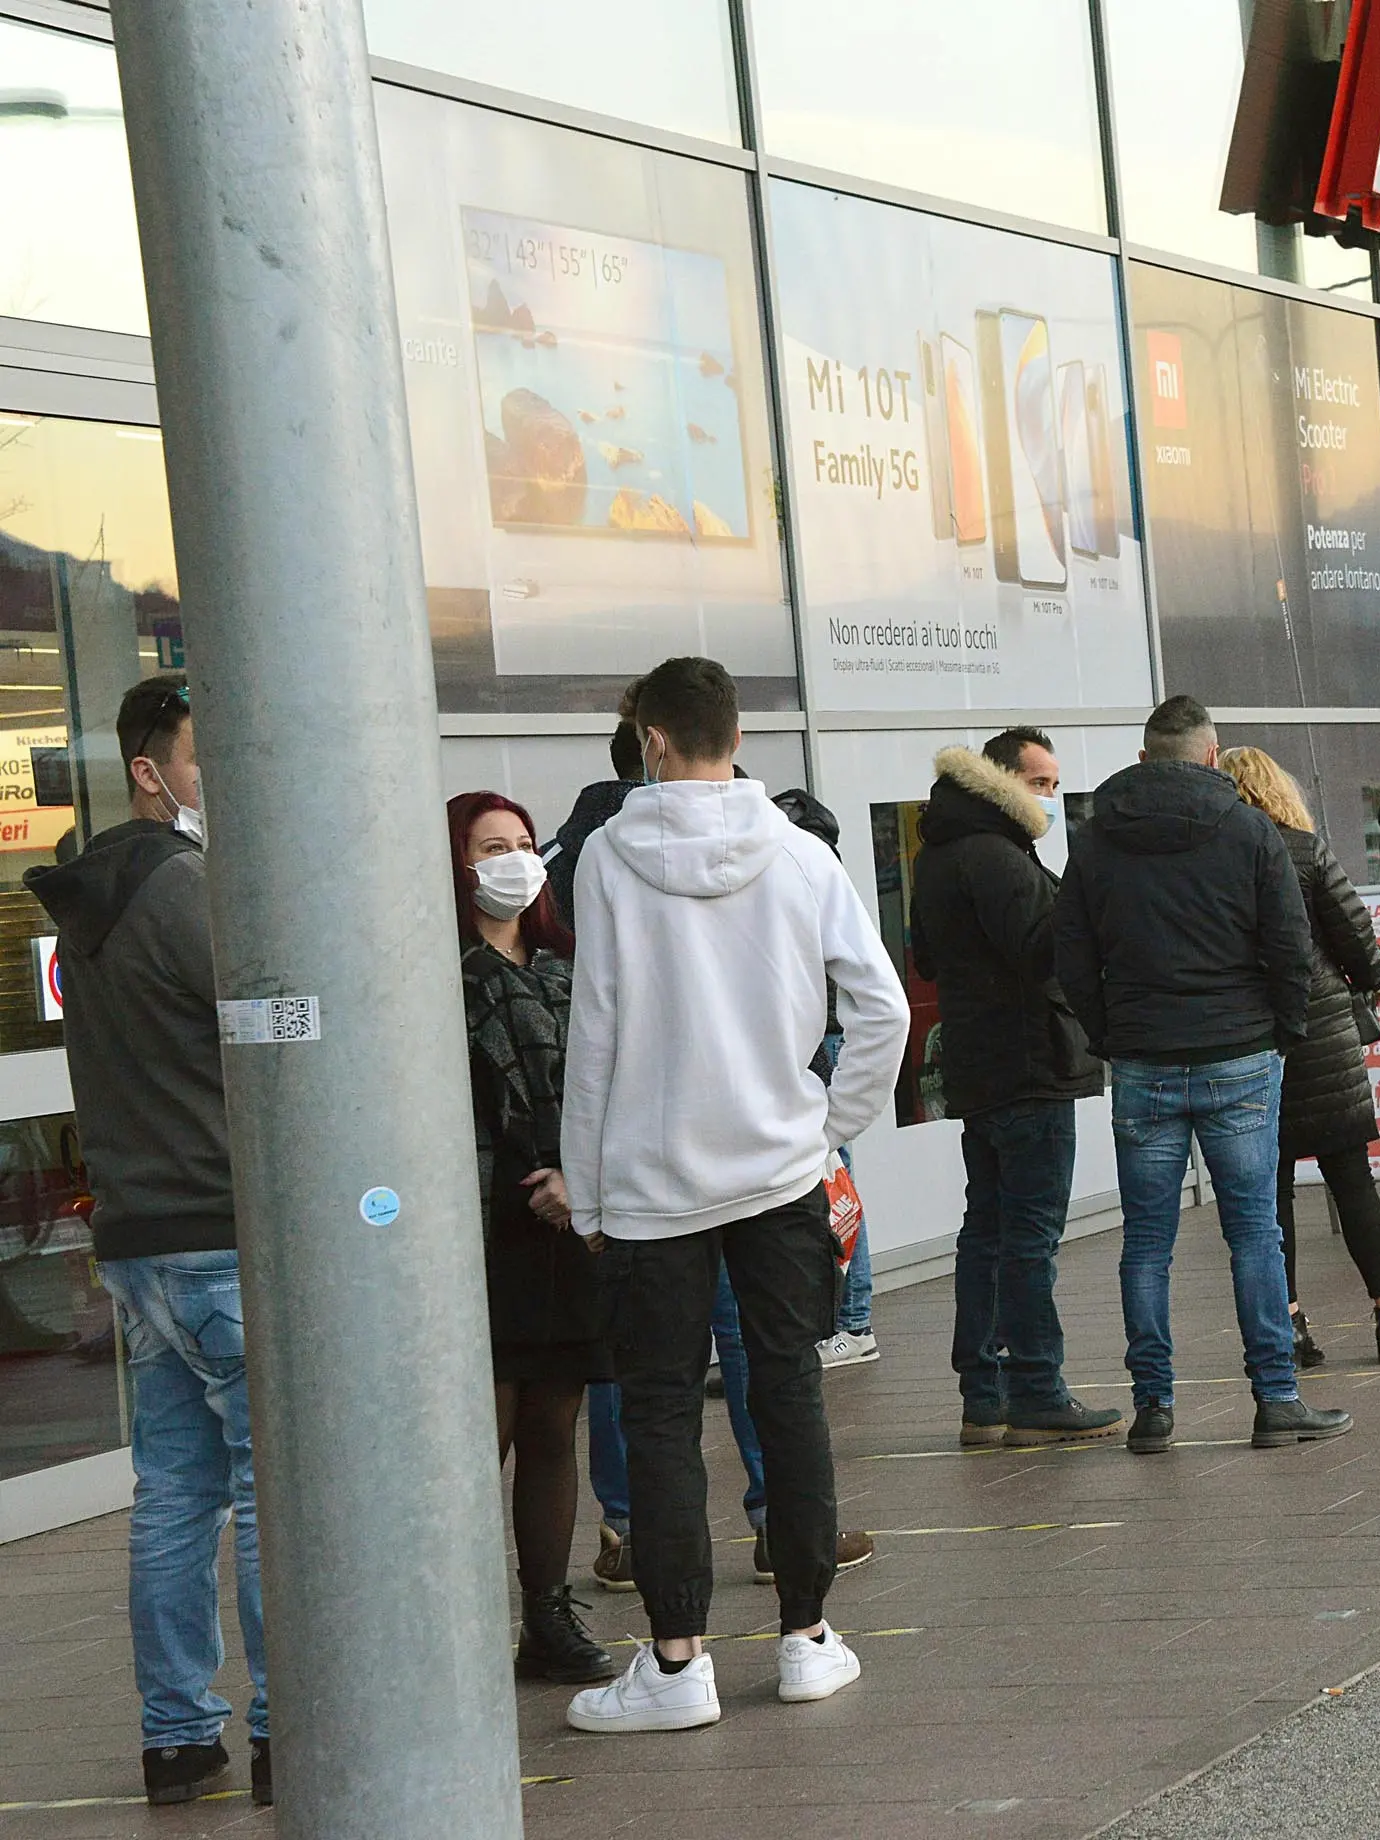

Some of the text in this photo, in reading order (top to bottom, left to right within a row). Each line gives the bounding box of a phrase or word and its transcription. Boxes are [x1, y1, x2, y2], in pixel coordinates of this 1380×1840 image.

[516, 239, 544, 269] 43"
[559, 246, 586, 276] 55"
[601, 253, 628, 283] 65"
[807, 356, 911, 422] Mi 10T
[1295, 366, 1360, 407] Mi Electric
[1298, 416, 1347, 450] Scooter
[813, 440, 919, 500] Family 5G
[1156, 445, 1191, 466] xiaomi
[1307, 524, 1366, 556] Potenza per
[1311, 563, 1380, 591] andare lontano
[1041, 602, 1051, 614] 10T
[1052, 603, 1062, 614] Pro
[829, 617, 998, 650] Non crederai ai tuoi occhi
[0, 820, 28, 842] eri
